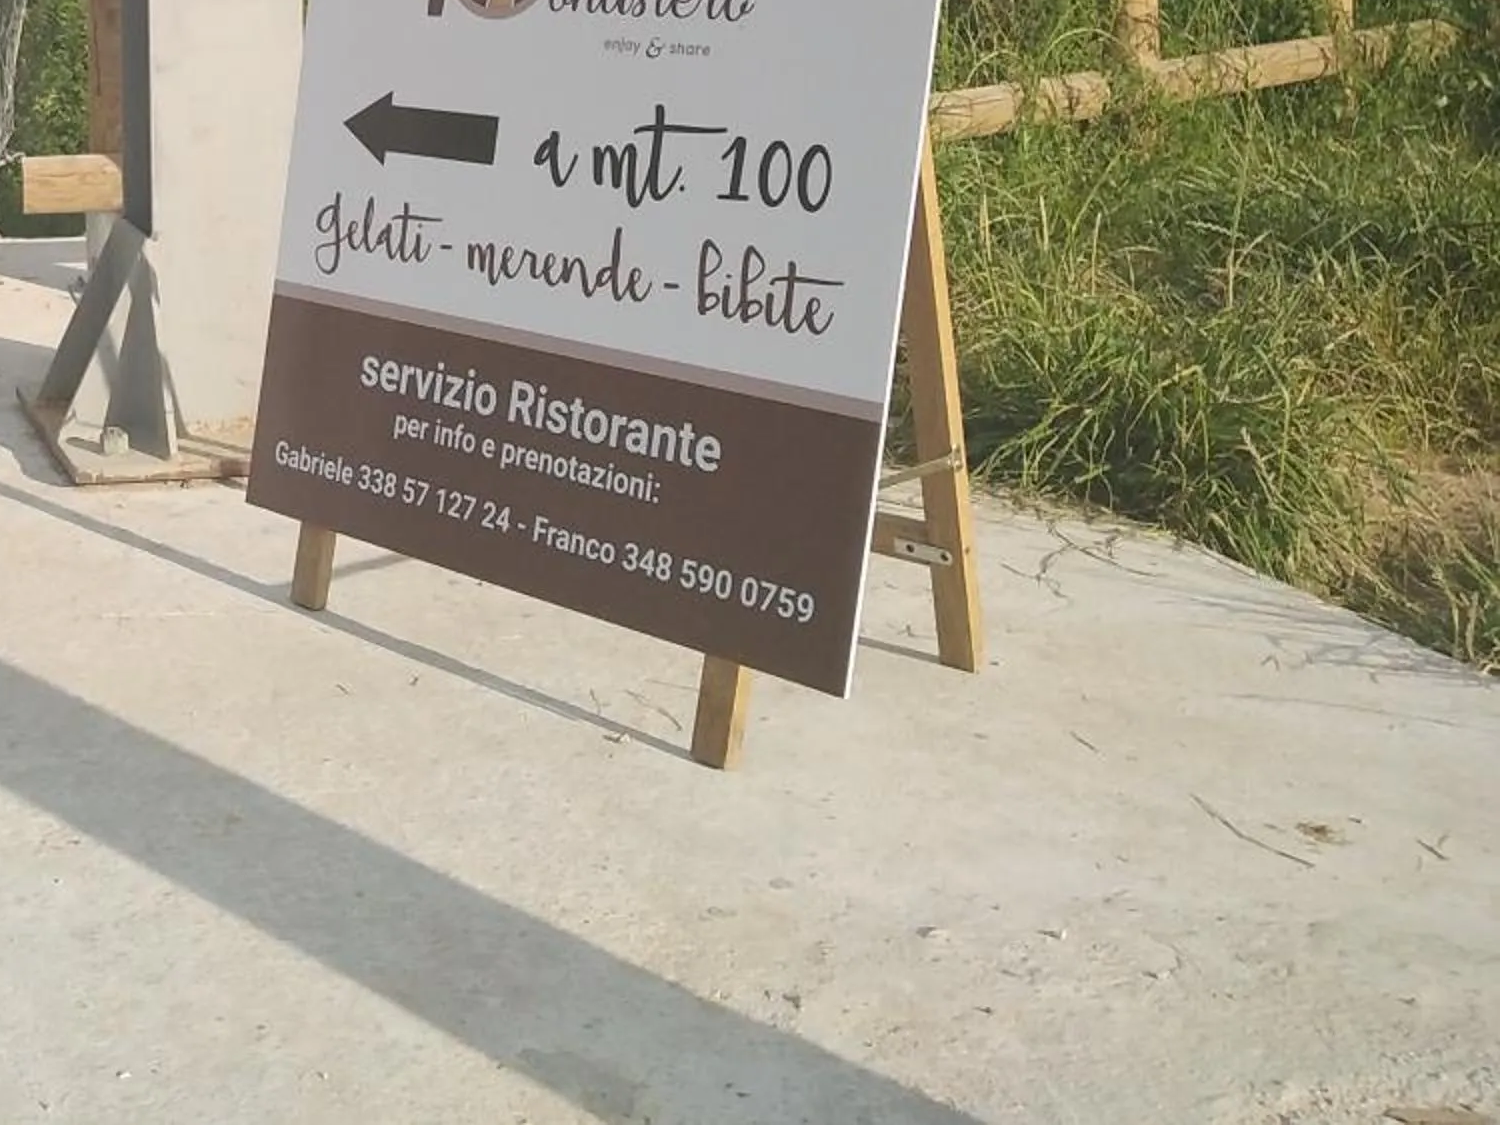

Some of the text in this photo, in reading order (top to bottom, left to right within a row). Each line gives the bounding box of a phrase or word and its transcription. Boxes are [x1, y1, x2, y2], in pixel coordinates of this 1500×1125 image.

[603, 36, 712, 60] enjoy & share
[532, 129, 579, 189] a
[714, 134, 834, 214] 100
[696, 237, 846, 337] bibite
[359, 354, 723, 474] servizio Ristorante
[392, 411, 663, 505] per info e prenotazioni:
[274, 438, 354, 487] Gabriele
[356, 462, 398, 500] 338
[401, 475, 431, 508] 57
[435, 487, 478, 522] 127
[480, 499, 512, 534] 24
[531, 513, 617, 566] Franco
[621, 540, 675, 583] 348
[679, 557, 734, 601] 590
[739, 575, 816, 625] 0759
